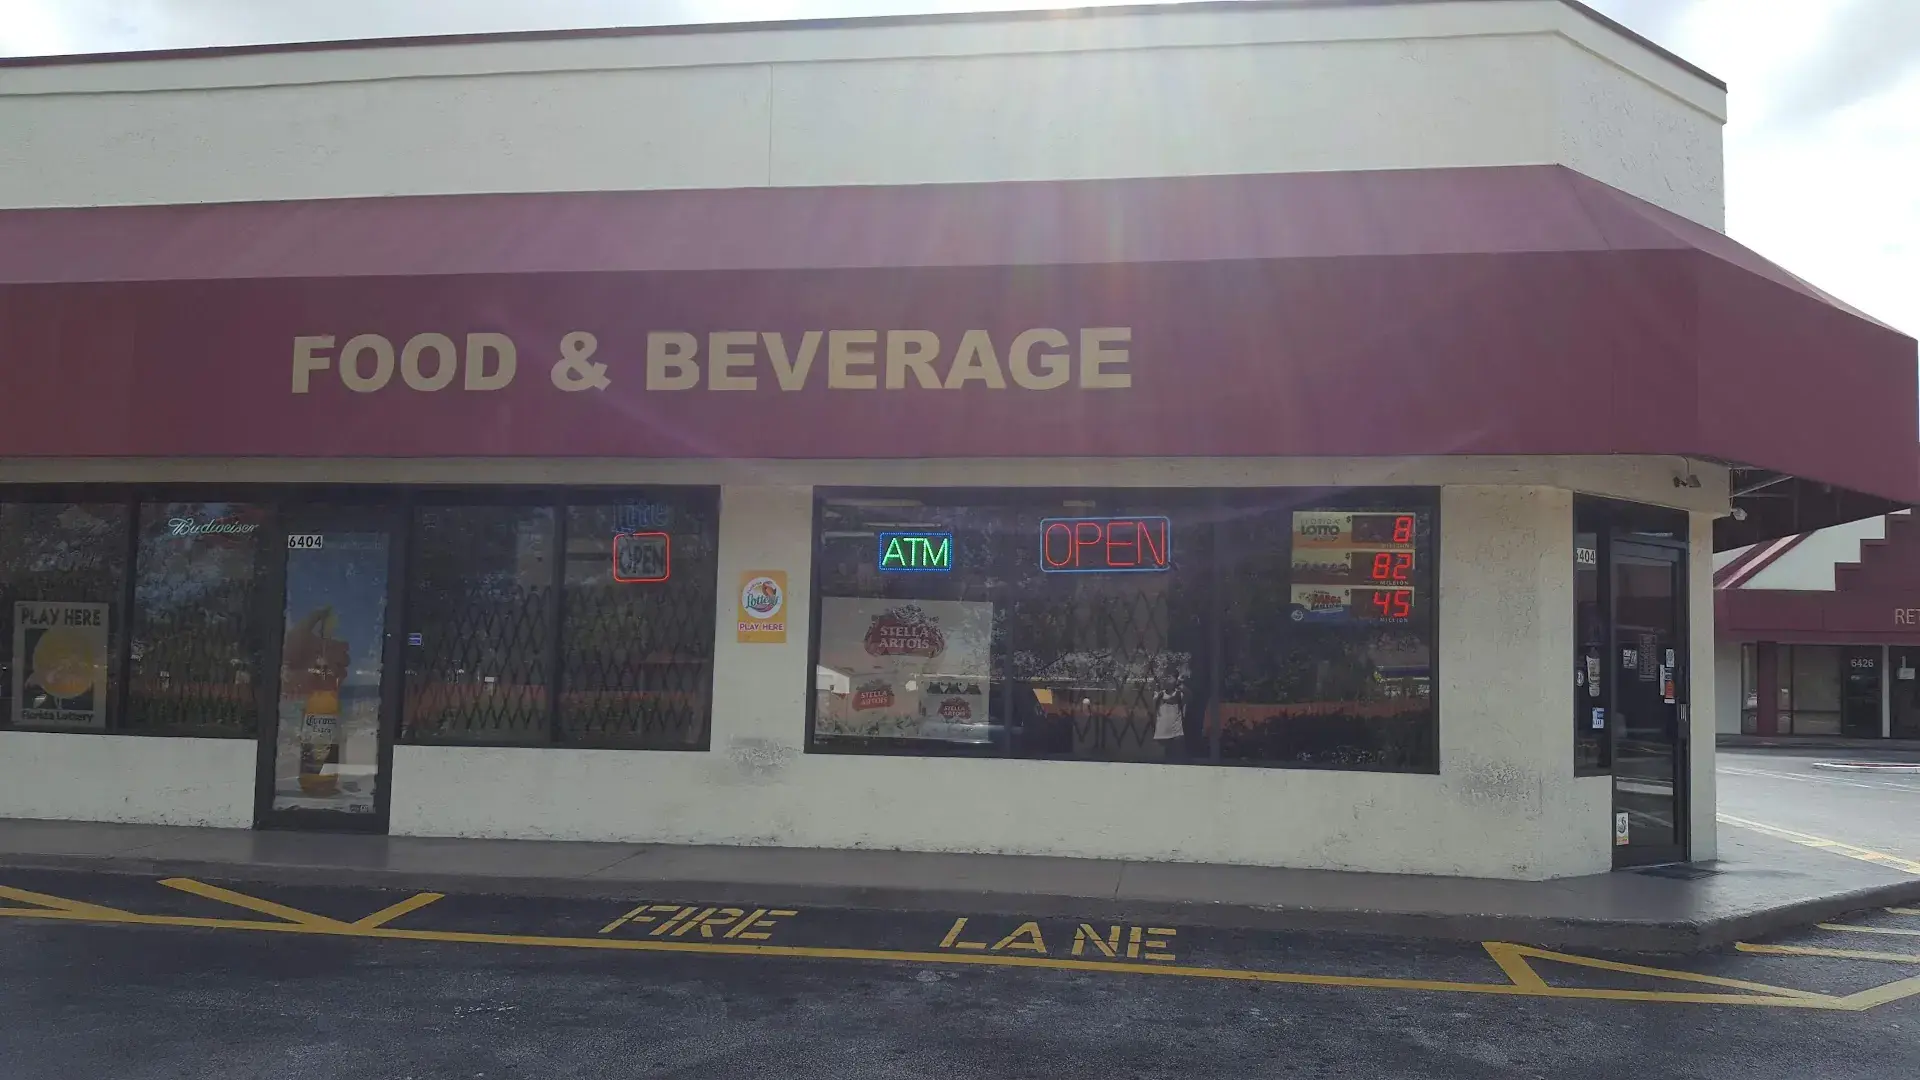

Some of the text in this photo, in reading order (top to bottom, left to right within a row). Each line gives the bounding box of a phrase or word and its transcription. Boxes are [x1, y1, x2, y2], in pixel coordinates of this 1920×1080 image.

[291, 326, 1133, 394] FOOD & BEVERAGE
[168, 517, 260, 537] Budweiser
[1301, 525, 1341, 536] LOTTO
[1393, 516, 1413, 543] 8
[289, 535, 322, 548] 6404
[1044, 521, 1167, 567] OPEN
[618, 544, 665, 575] OPEN
[881, 537, 949, 567] ATM
[1372, 552, 1411, 580] 82
[1373, 590, 1411, 617] 45
[21, 607, 102, 627] PLAY HERE
[739, 623, 784, 631] PLAY HERE
[879, 626, 930, 638] STELLA
[878, 638, 931, 650] ARTOIS
[1850, 658, 1874, 668] 6426
[860, 690, 888, 699] STELLA
[21, 709, 94, 724] Florida Lottery
[598, 904, 1177, 962] FIRE LANE
